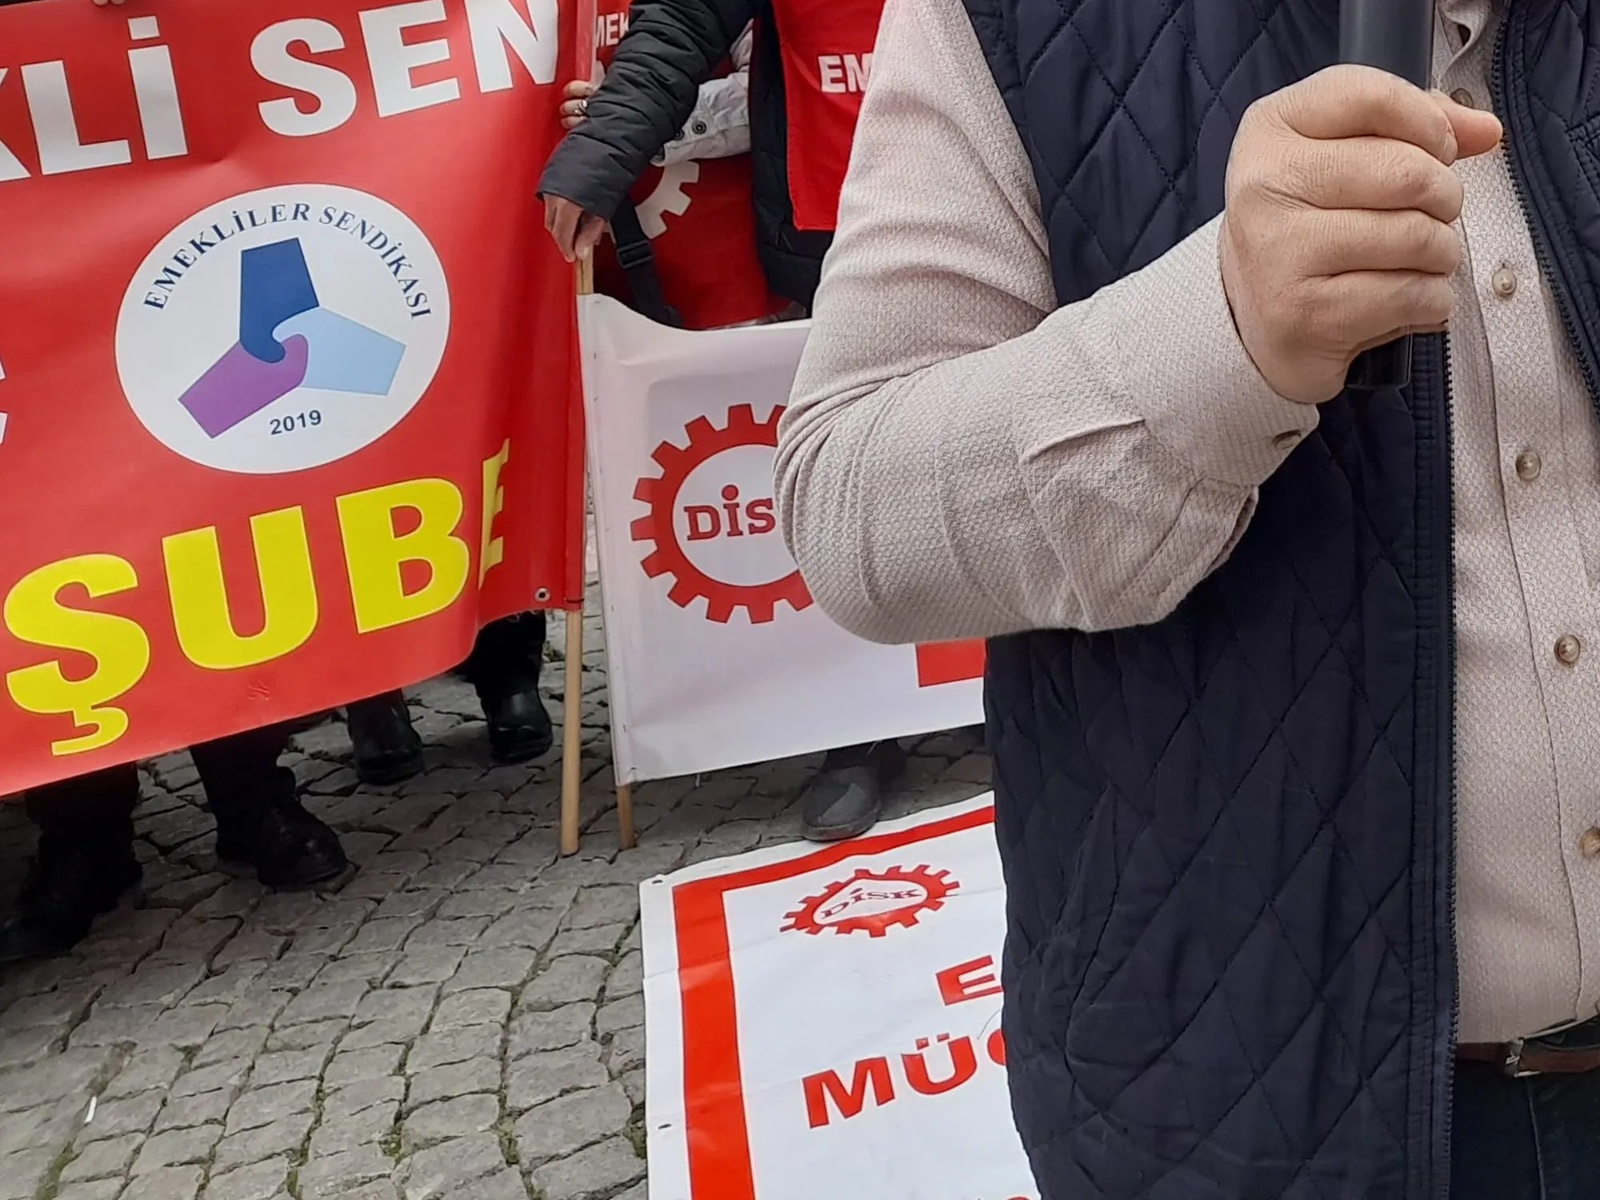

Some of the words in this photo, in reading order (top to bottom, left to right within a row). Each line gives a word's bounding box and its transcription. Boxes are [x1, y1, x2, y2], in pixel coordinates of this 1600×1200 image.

[143, 203, 310, 310] EMEKLİLER
[318, 205, 432, 320] SENDİKASI
[269, 409, 322, 436] 2019
[684, 485, 776, 541] DİS
[3, 437, 510, 756] ŞUBE
[820, 887, 923, 920] DİSK
[936, 954, 1004, 1006] E
